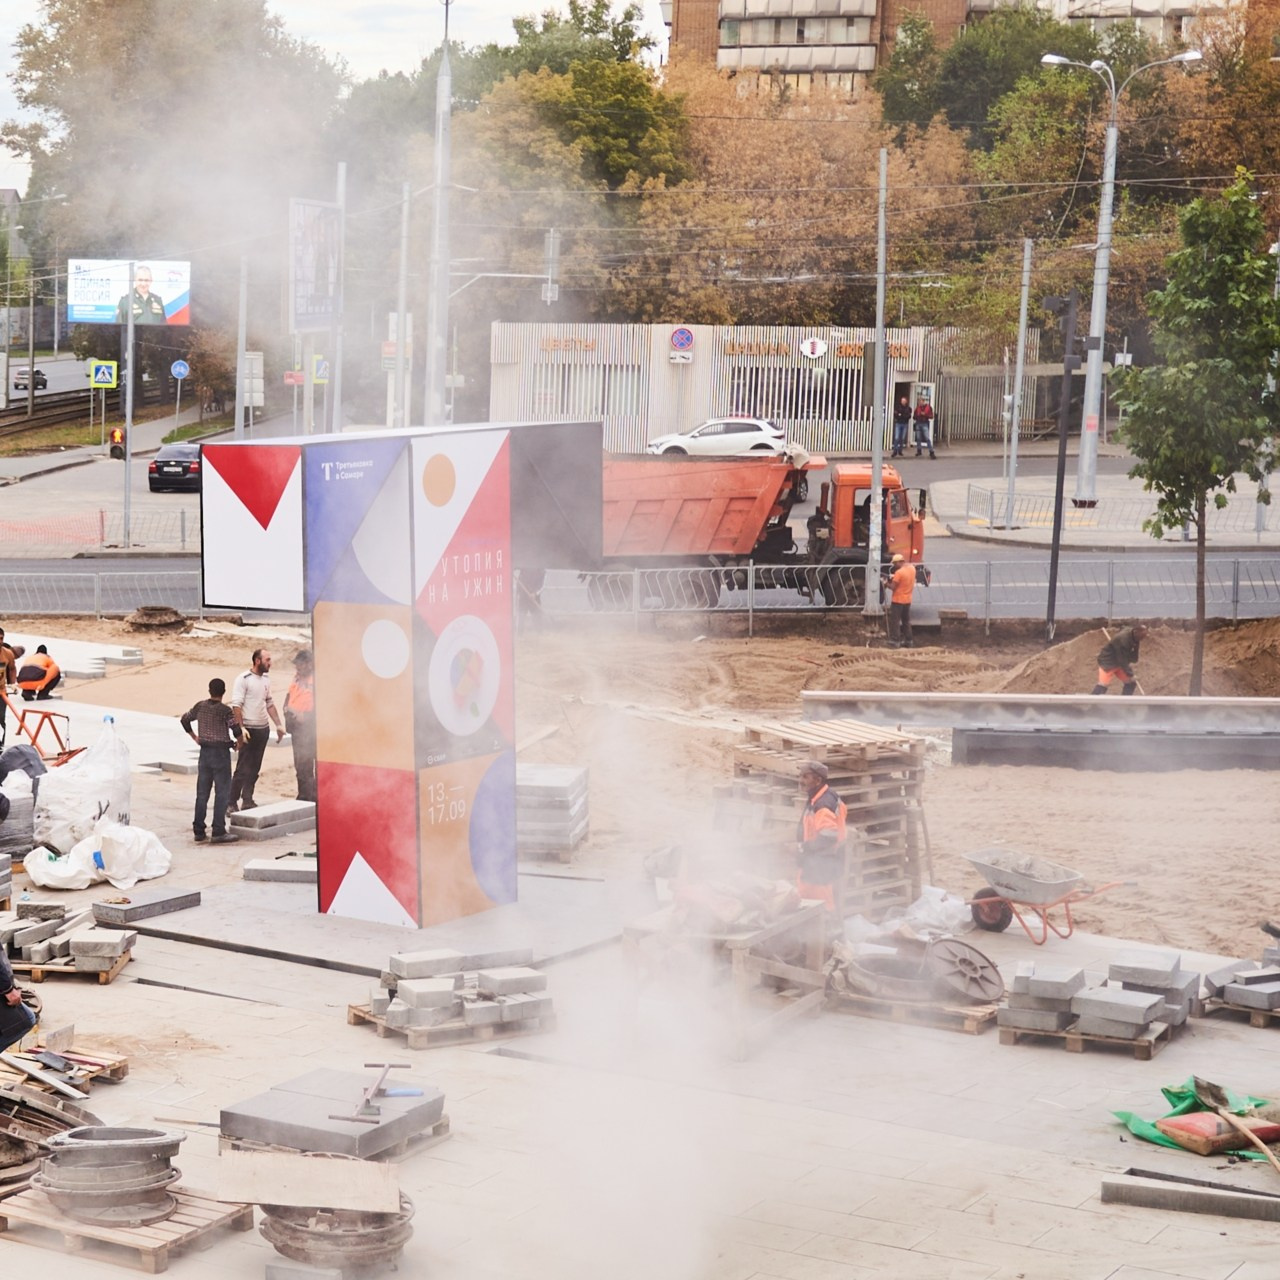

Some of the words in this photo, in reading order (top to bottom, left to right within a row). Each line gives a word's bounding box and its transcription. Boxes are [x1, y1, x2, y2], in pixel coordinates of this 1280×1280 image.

[73, 277, 112, 289] ЕДИНАЯ
[73, 289, 112, 302] РОССИЯ
[441, 549, 503, 577] УТОПИЯ
[428, 583, 449, 604] НА
[463, 573, 503, 599] УЖИН
[428, 799, 466, 825] 17.09
